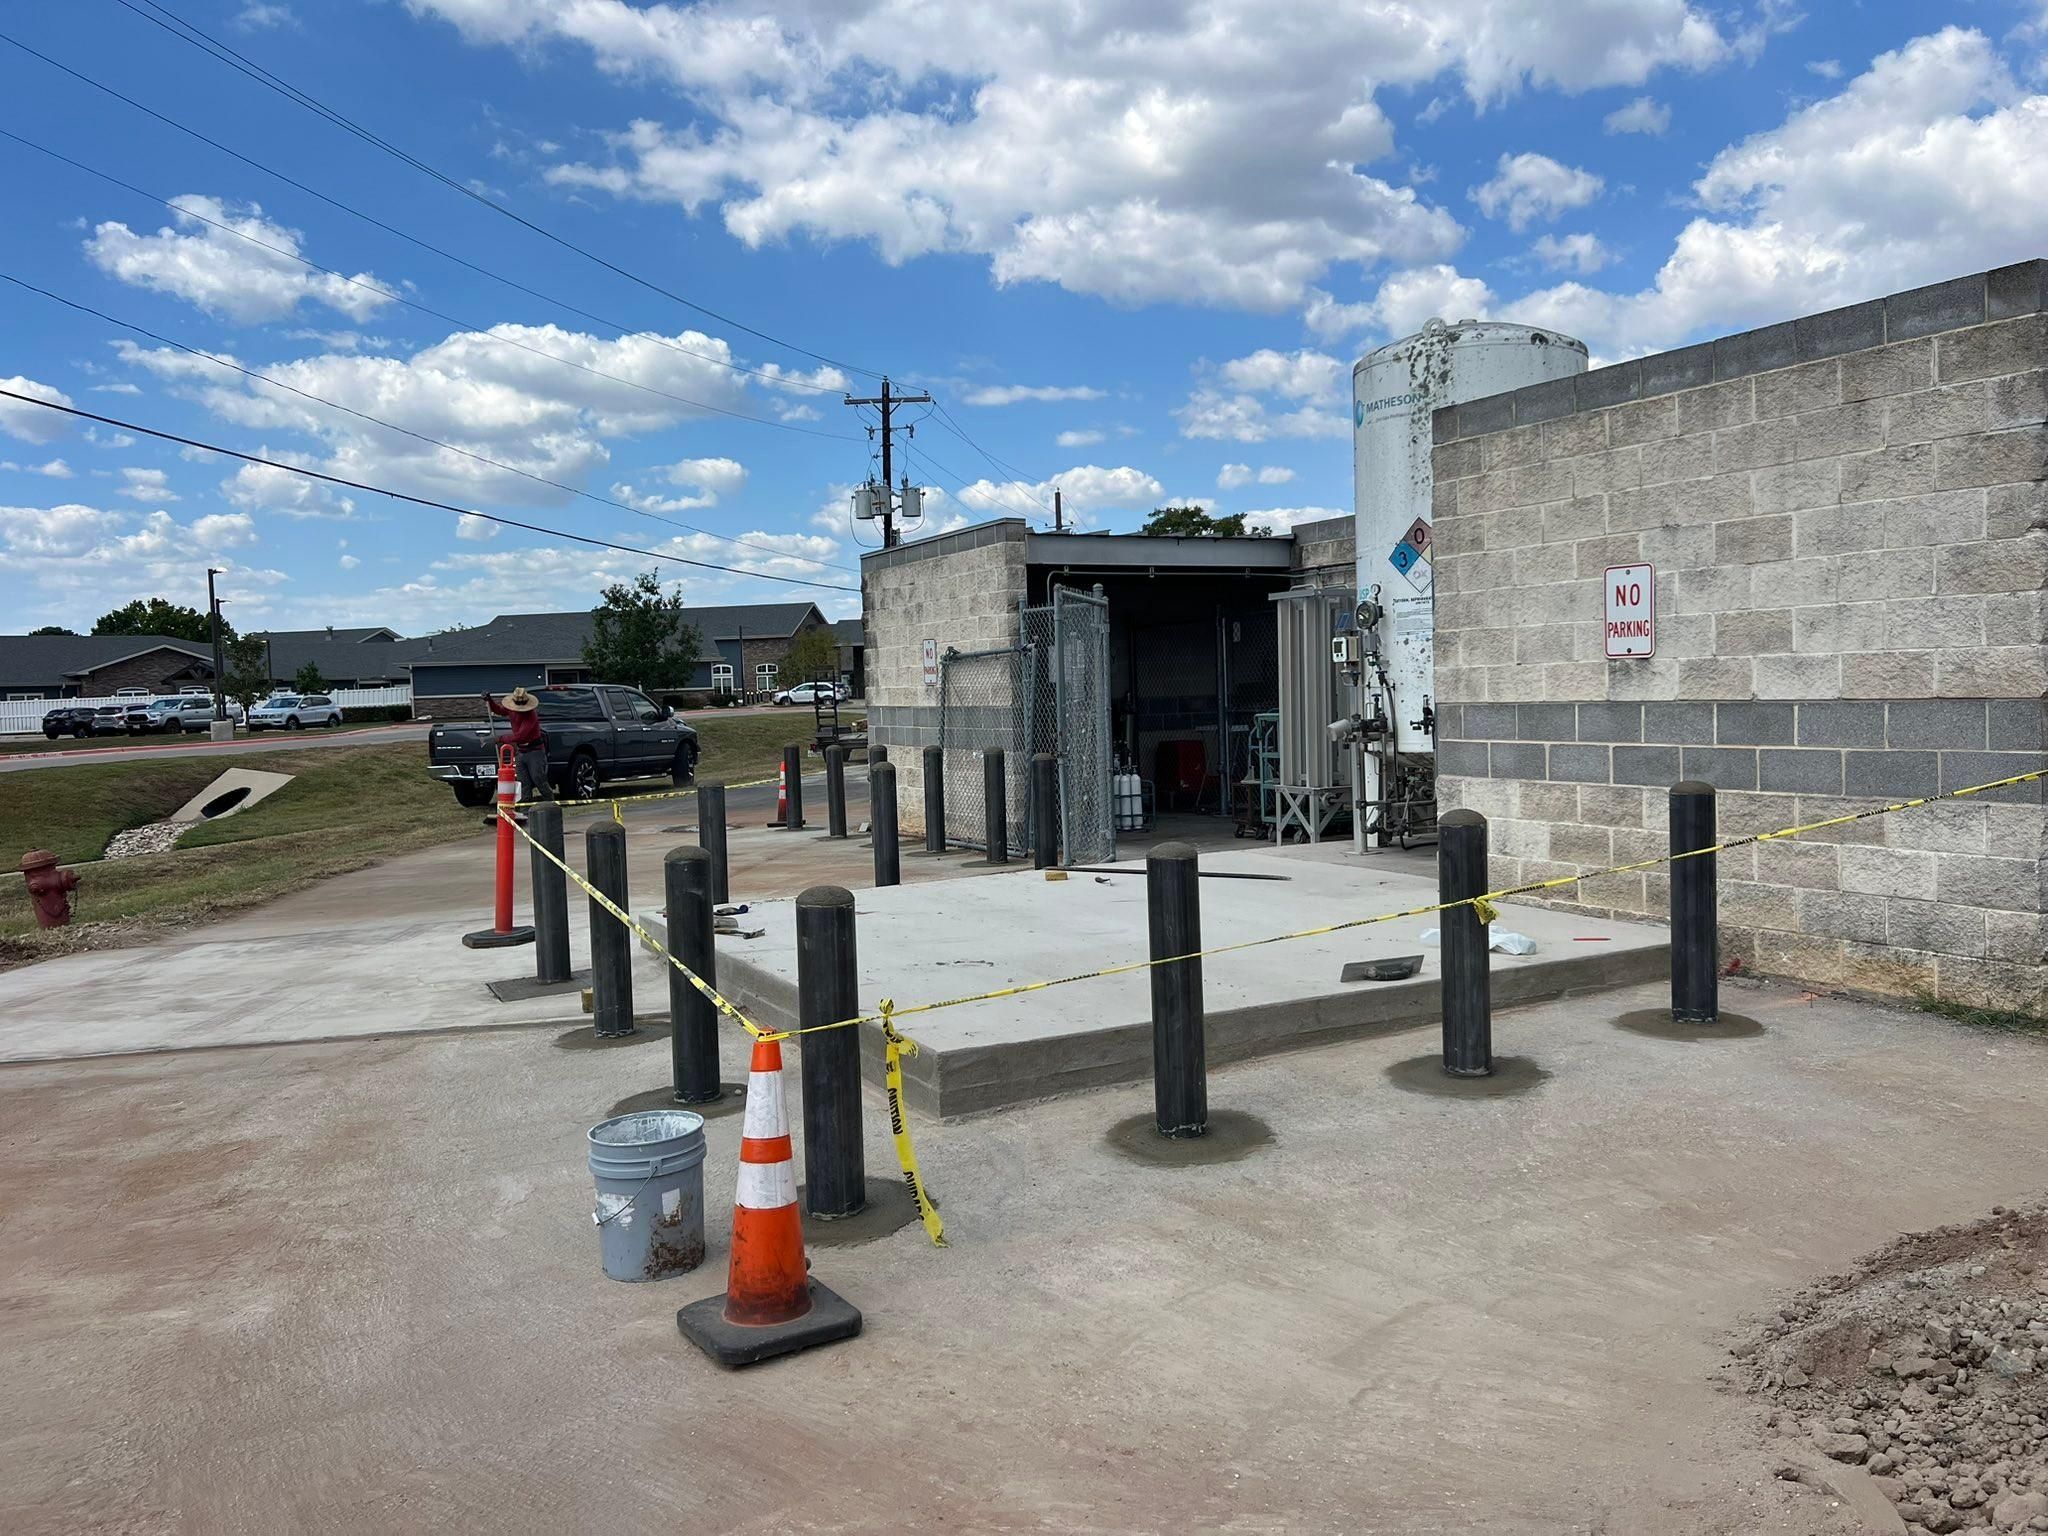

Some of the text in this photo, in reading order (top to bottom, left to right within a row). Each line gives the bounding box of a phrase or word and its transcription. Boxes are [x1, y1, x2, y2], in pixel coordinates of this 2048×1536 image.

[1366, 393, 1421, 413] MATHESON
[1414, 528, 1424, 544] 0
[1398, 551, 1407, 568] 3
[1615, 583, 1640, 607] NO
[1608, 619, 1650, 638] PARKING
